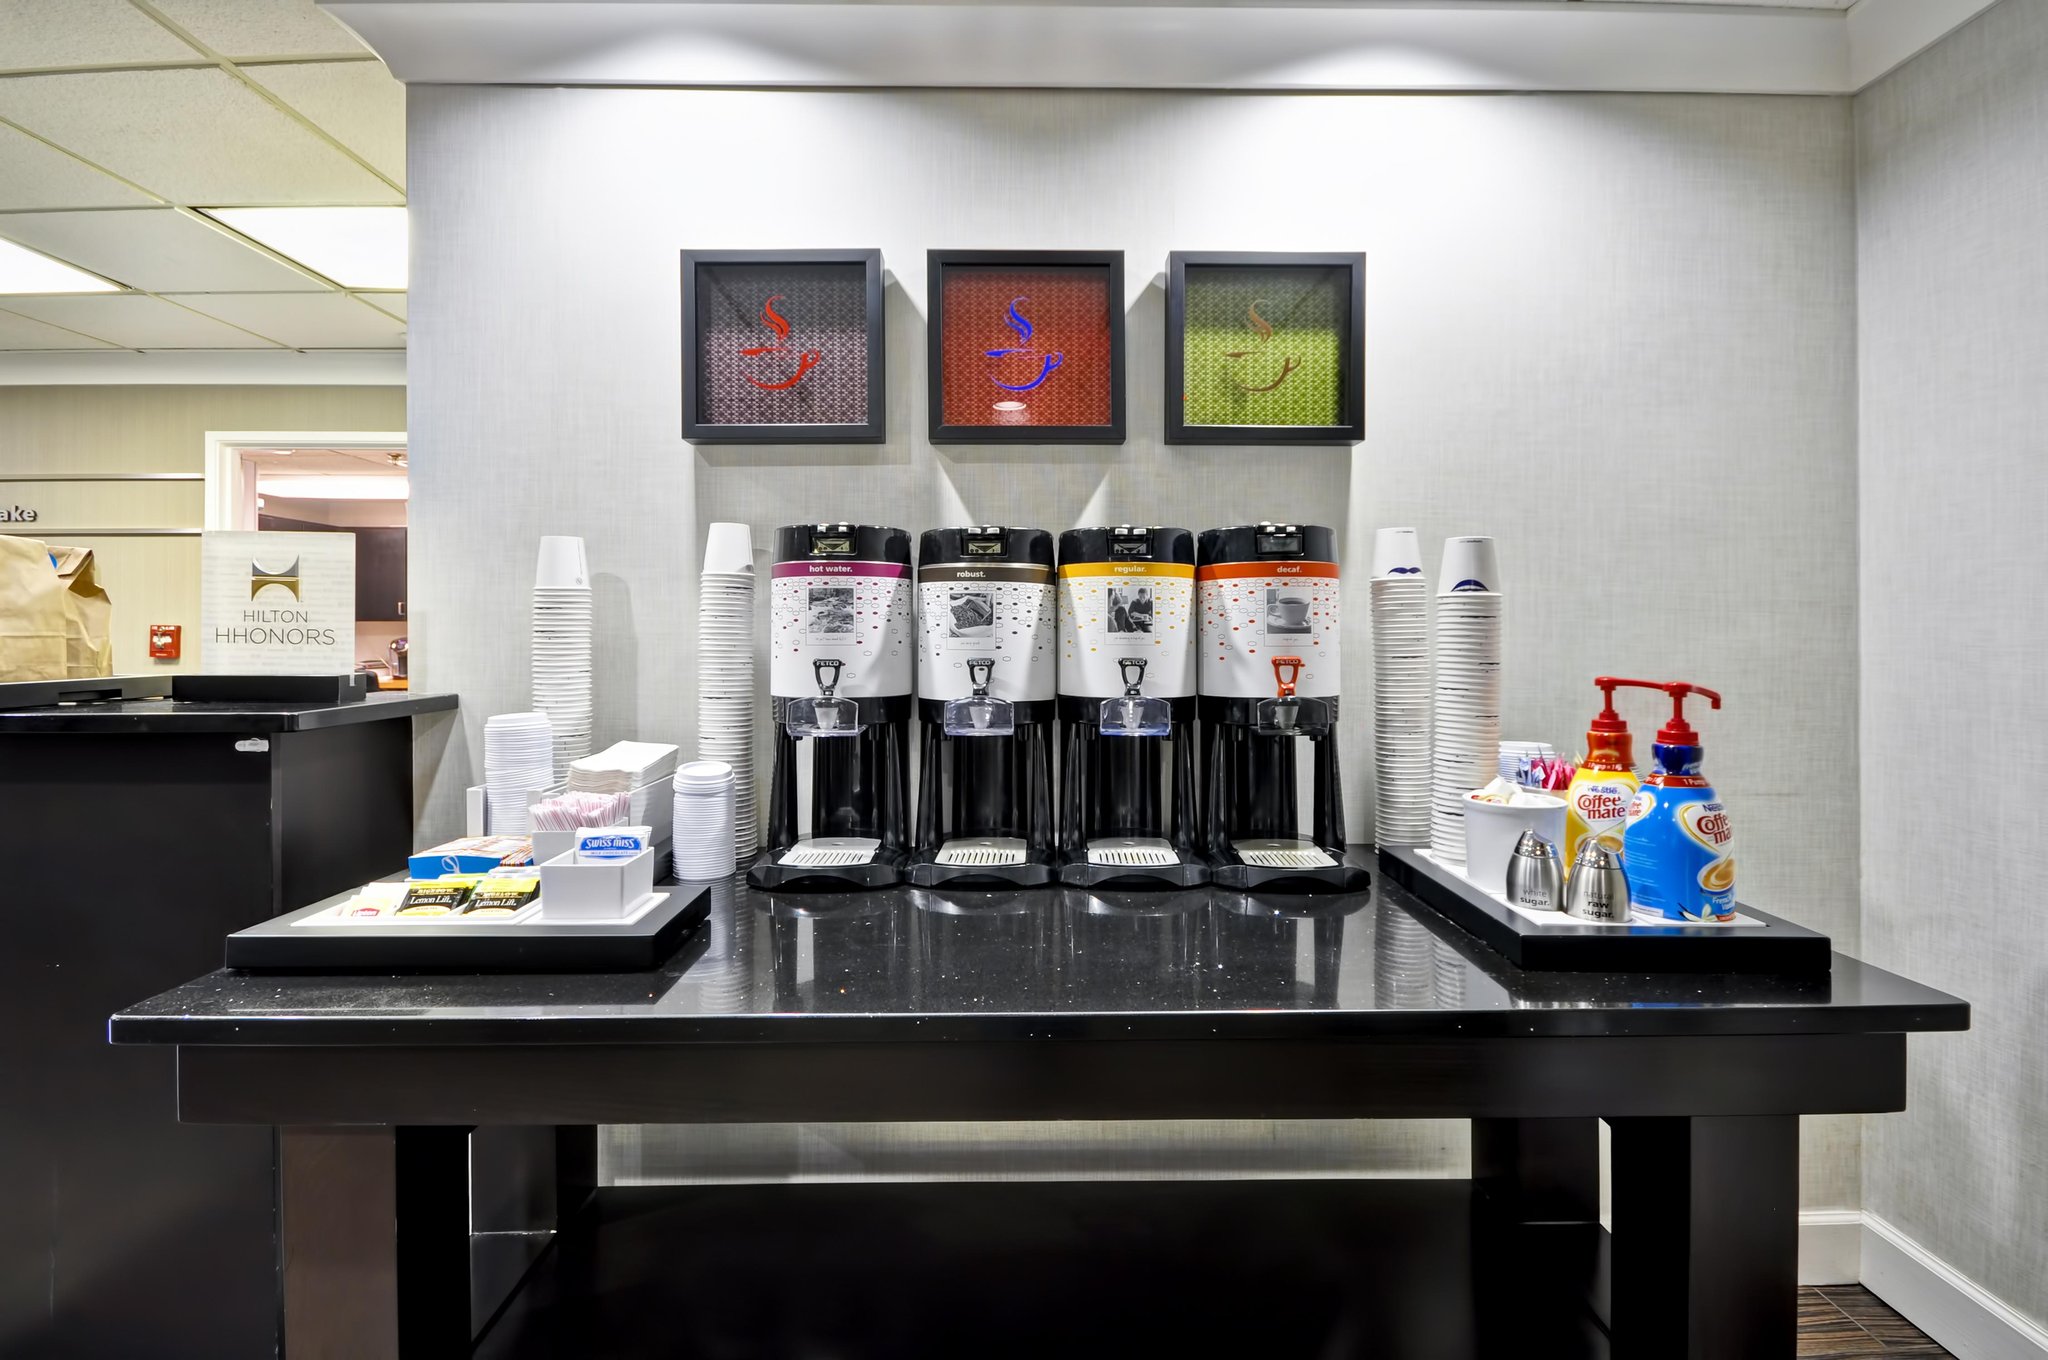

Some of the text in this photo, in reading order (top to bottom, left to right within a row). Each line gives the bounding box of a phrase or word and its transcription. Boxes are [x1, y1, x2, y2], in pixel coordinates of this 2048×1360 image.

[809, 565, 853, 573] hot water.
[1114, 565, 1147, 574] regular.
[1276, 565, 1303, 573] decaf.
[956, 570, 986, 578] robust.
[243, 610, 308, 623] HILTON
[215, 627, 336, 646] HHONORS
[1587, 807, 1626, 819] mate
[1523, 889, 1547, 897] white
[410, 896, 436, 905] Lemon
[475, 899, 501, 907] Lemon
[1520, 896, 1550, 906] sugar.
[1587, 901, 1610, 909] raw
[1582, 908, 1615, 918] sugar.
